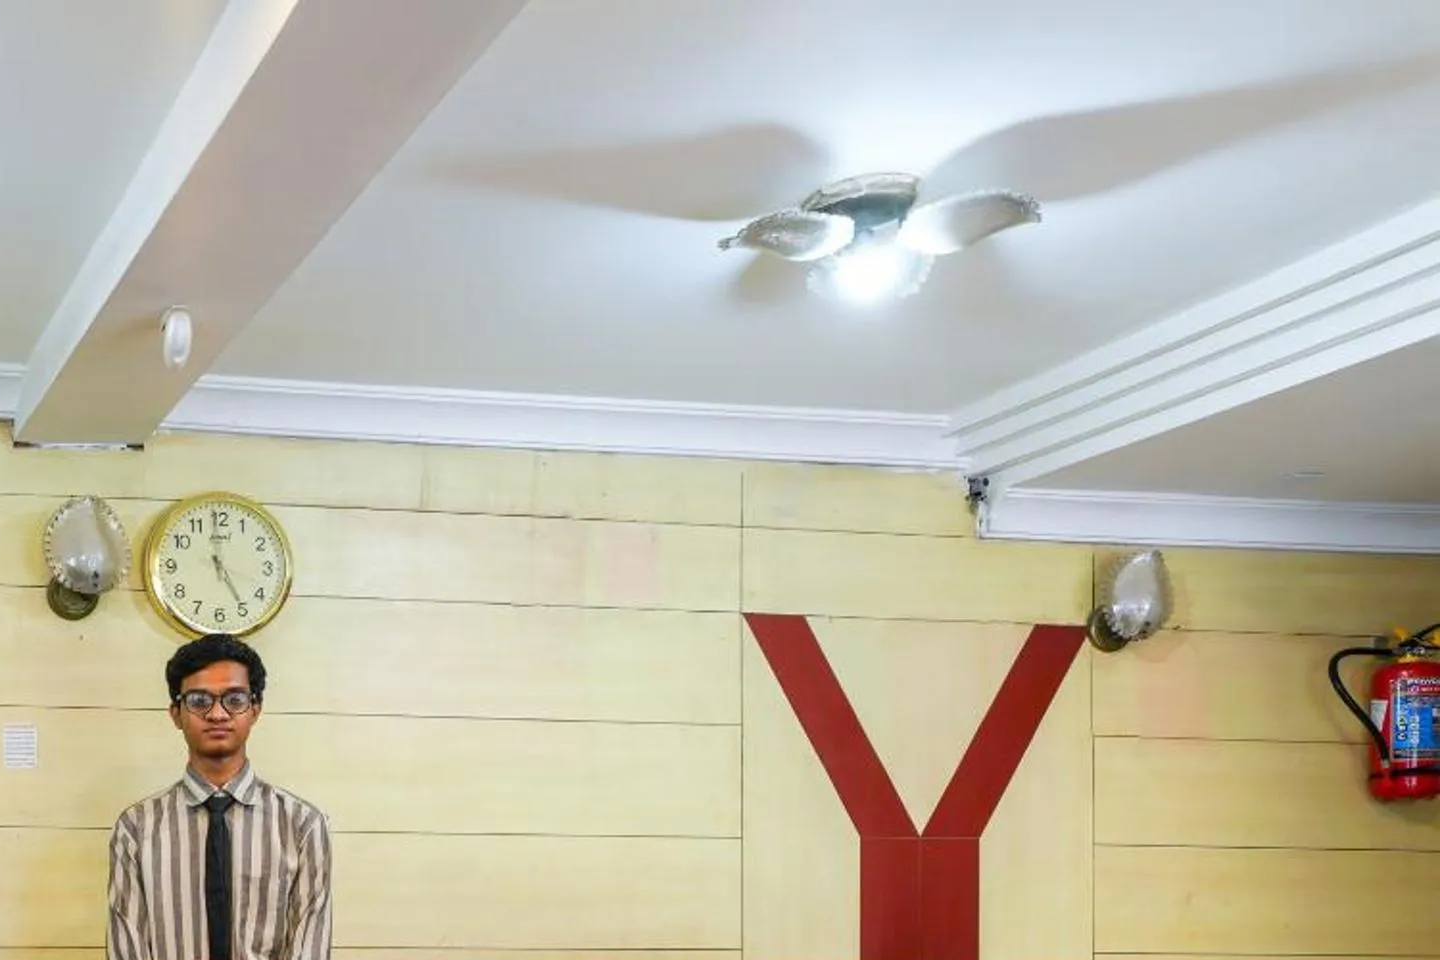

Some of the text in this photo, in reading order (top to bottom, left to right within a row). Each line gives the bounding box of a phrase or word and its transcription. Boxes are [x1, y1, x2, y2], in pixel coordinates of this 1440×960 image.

[189, 518, 203, 533] 11
[211, 511, 229, 527] 12
[239, 519, 245, 533] 1
[173, 535, 191, 550] 10
[254, 536, 266, 552] 2
[165, 558, 177, 574] 9
[262, 560, 273, 576] 3
[174, 583, 185, 599] 8
[254, 587, 265, 600] 4
[193, 600, 203, 615] 7
[214, 607, 226, 623] 6
[237, 602, 248, 617] 5
